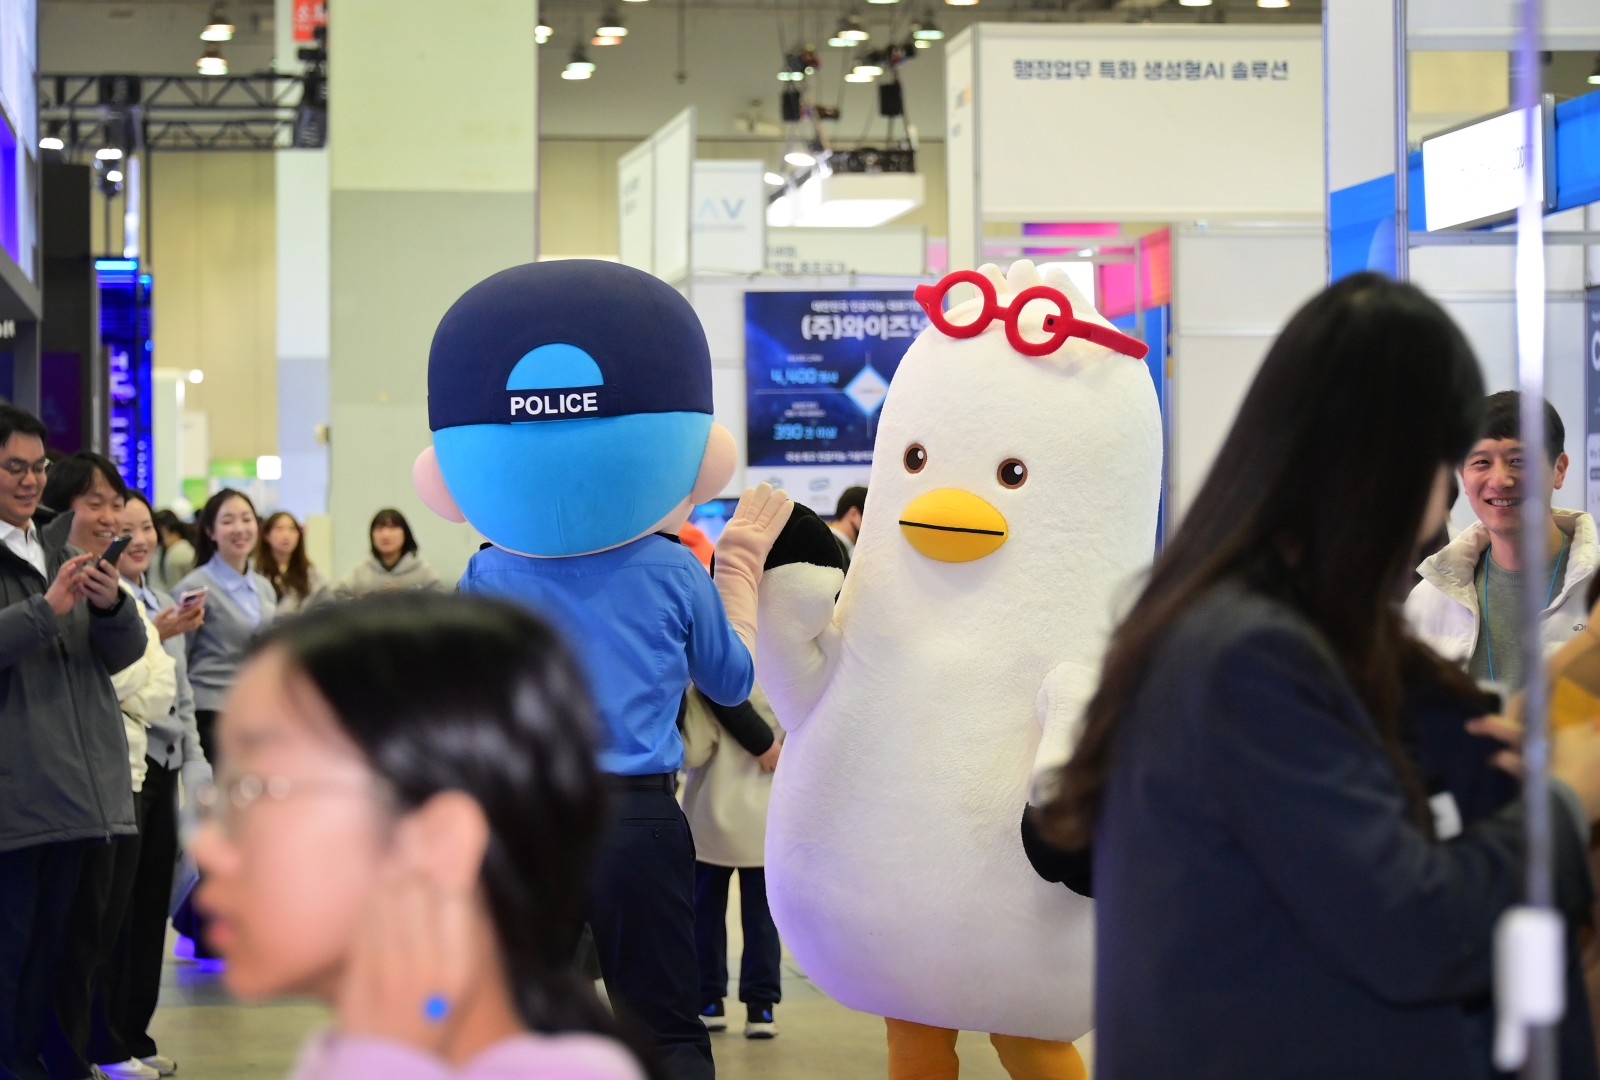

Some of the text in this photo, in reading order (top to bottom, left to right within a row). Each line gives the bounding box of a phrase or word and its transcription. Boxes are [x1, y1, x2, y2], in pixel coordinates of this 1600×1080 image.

[1013, 60, 1288, 80] 행정업무 특화 생성형AI 솔루션
[510, 392, 598, 416] POLICE
